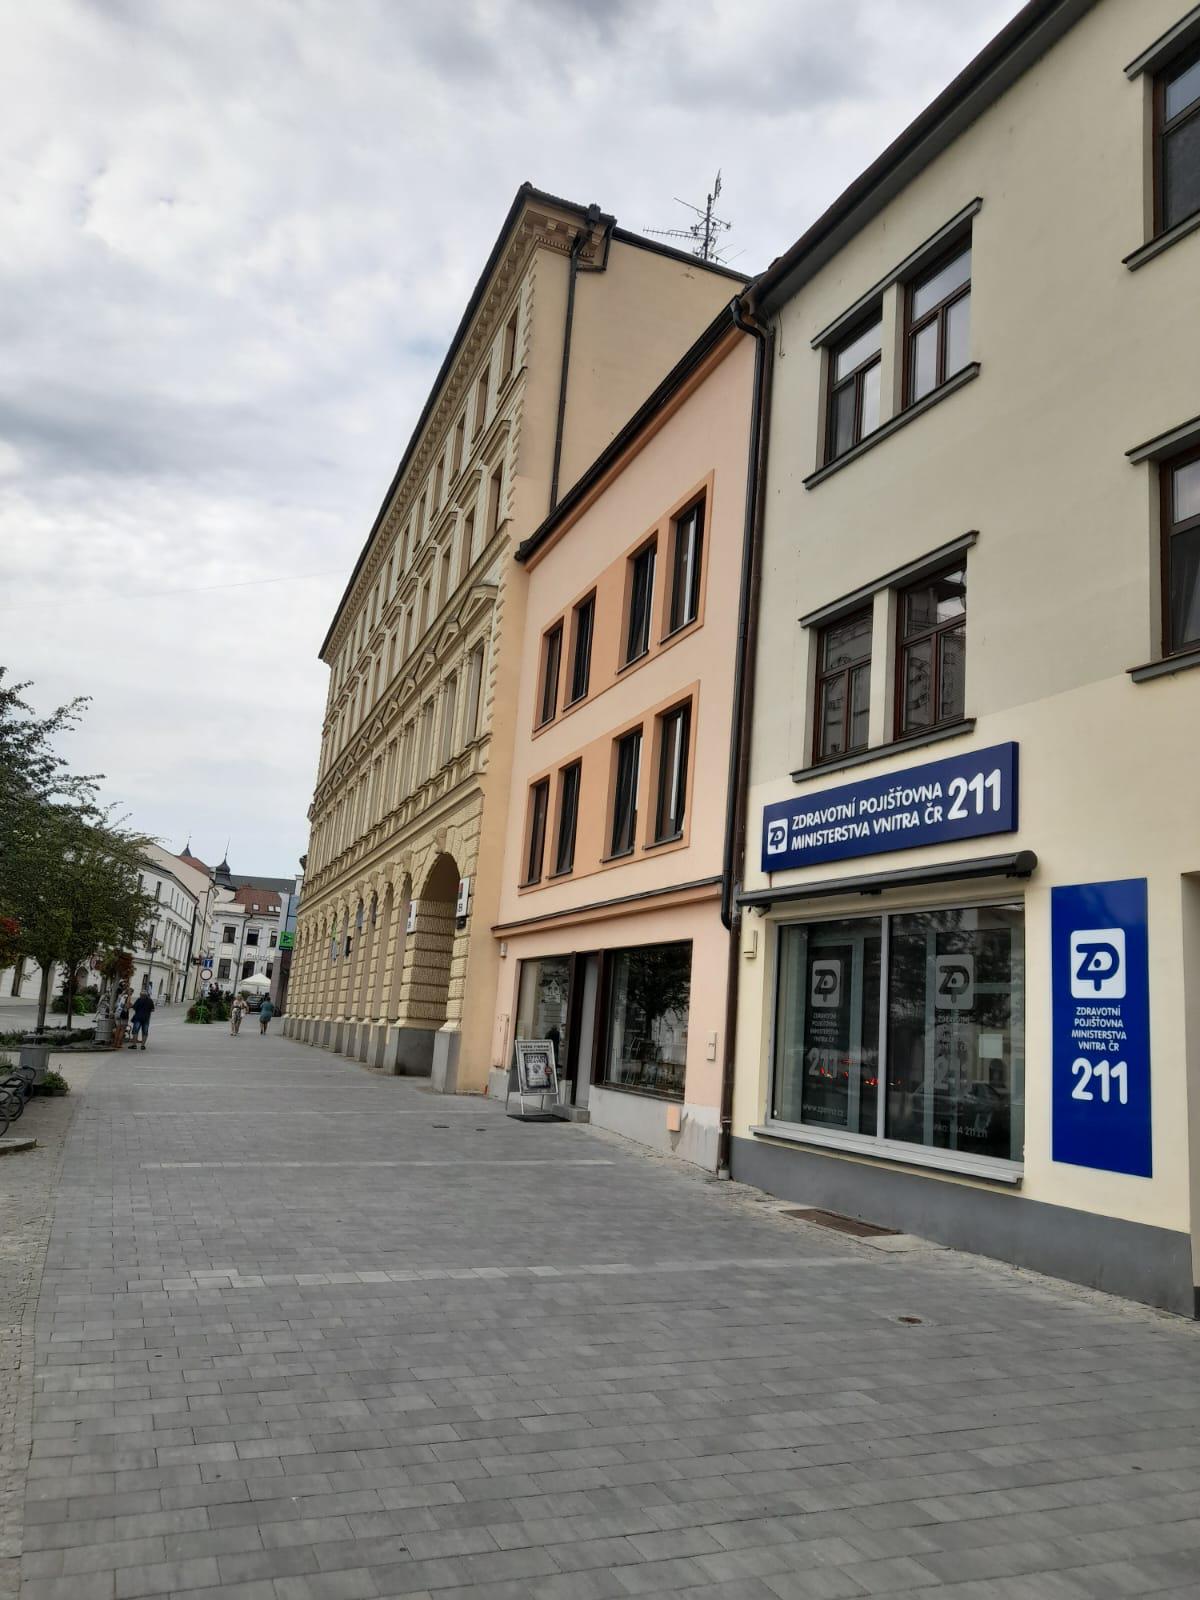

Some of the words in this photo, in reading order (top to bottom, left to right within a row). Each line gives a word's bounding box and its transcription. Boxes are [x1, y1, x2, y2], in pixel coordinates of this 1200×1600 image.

[792, 797, 856, 831] ZDRAVOTNÍ
[859, 782, 943, 816] POJIŠŤOVNA
[947, 768, 1001, 820] 211
[791, 821, 870, 851] MINISTERSTVA
[873, 812, 921, 834] VNITRA
[924, 802, 943, 825] ČR
[1074, 1017, 1123, 1028] POJIŠŤOVNA
[1075, 1005, 1121, 1017] ZDRAVOTNÍ
[1071, 1029, 1127, 1040] MINISTERSTVA
[1078, 1040, 1107, 1051] VNITRA
[1108, 1039, 1120, 1052] ČR
[1071, 1057, 1128, 1105] 211
